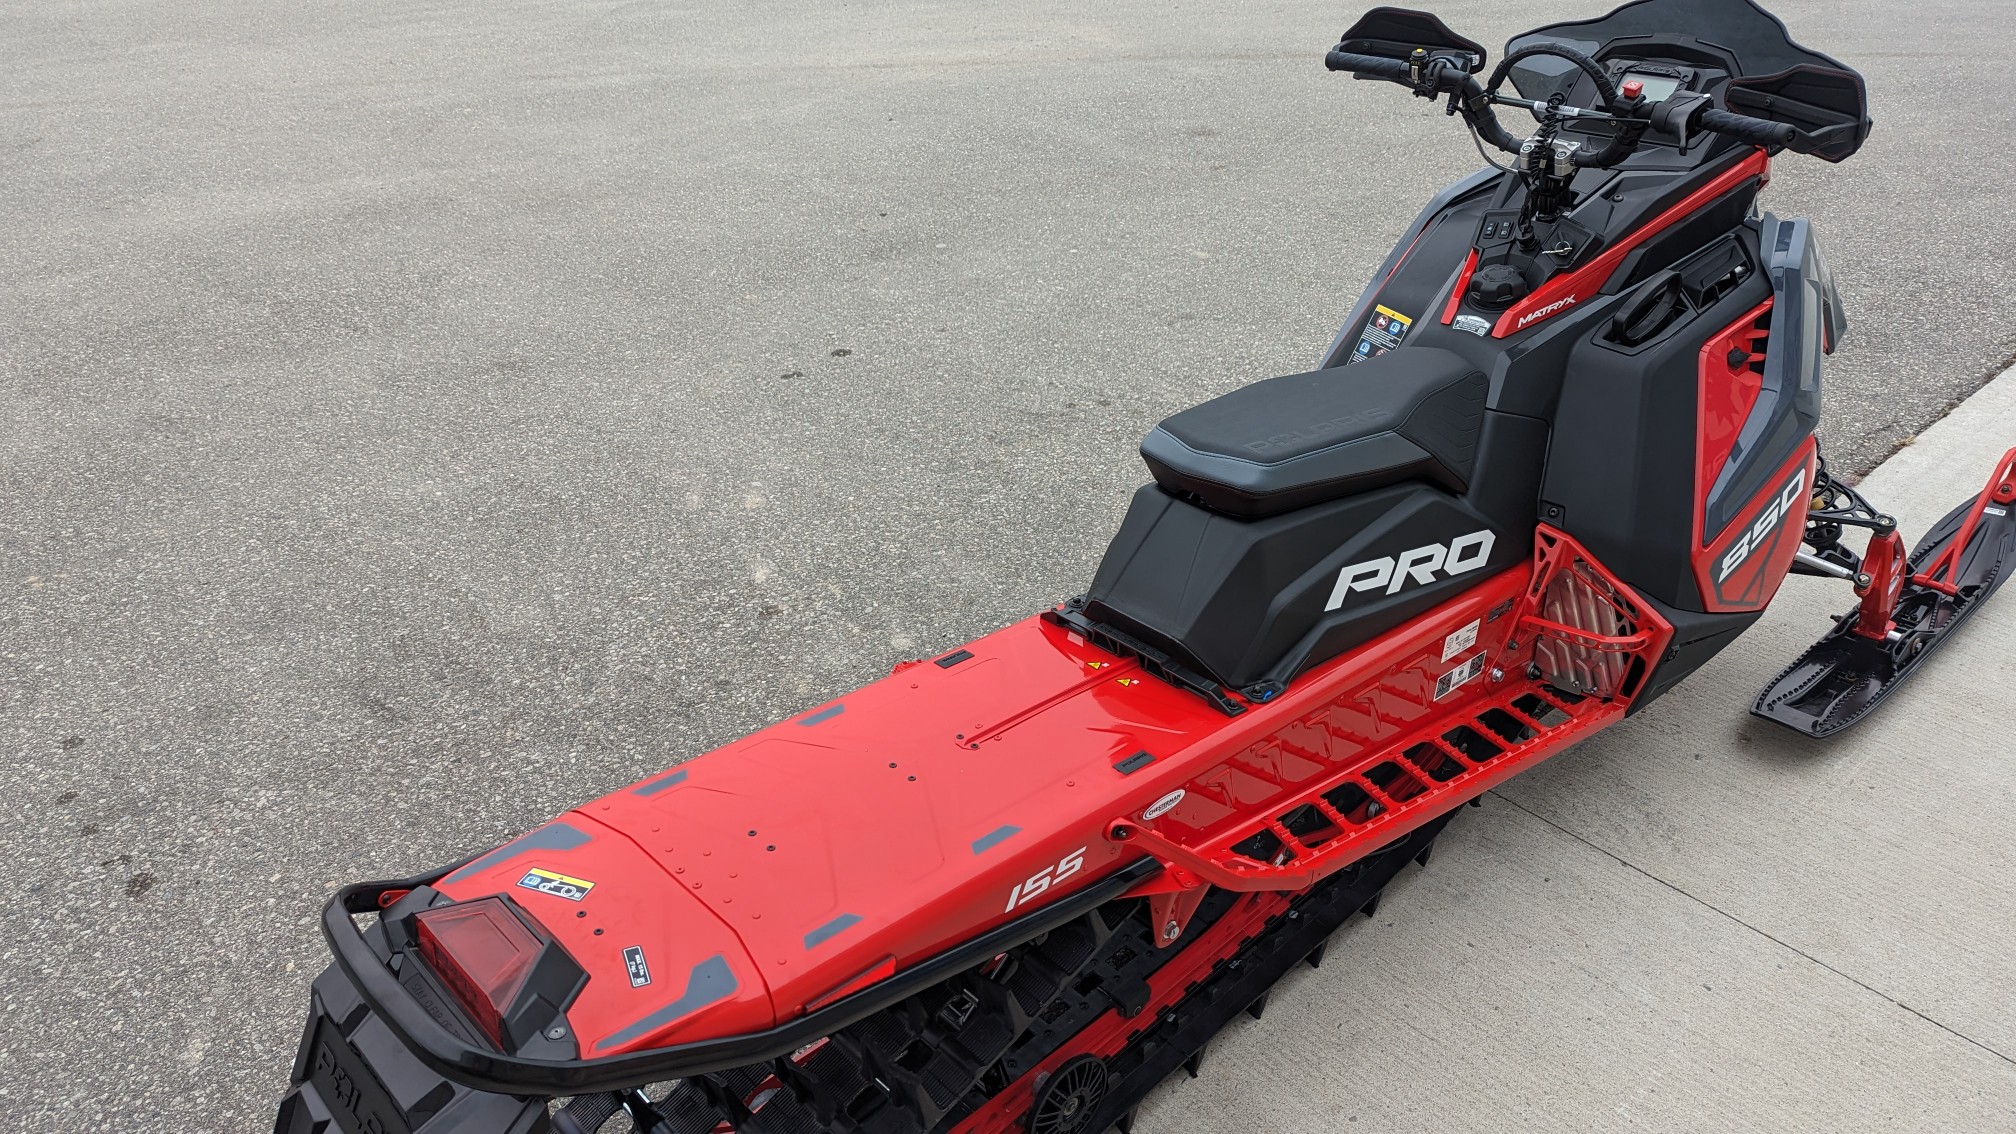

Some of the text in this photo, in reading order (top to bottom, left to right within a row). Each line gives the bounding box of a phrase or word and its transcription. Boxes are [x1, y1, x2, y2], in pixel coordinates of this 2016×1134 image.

[1517, 293, 1577, 329] MATRYX
[1243, 406, 1395, 454] POLARIS
[1718, 467, 1806, 584] 850
[1323, 528, 1496, 613] PRO
[1148, 792, 1182, 816] CHESTERMAN
[1004, 845, 1088, 915] 155
